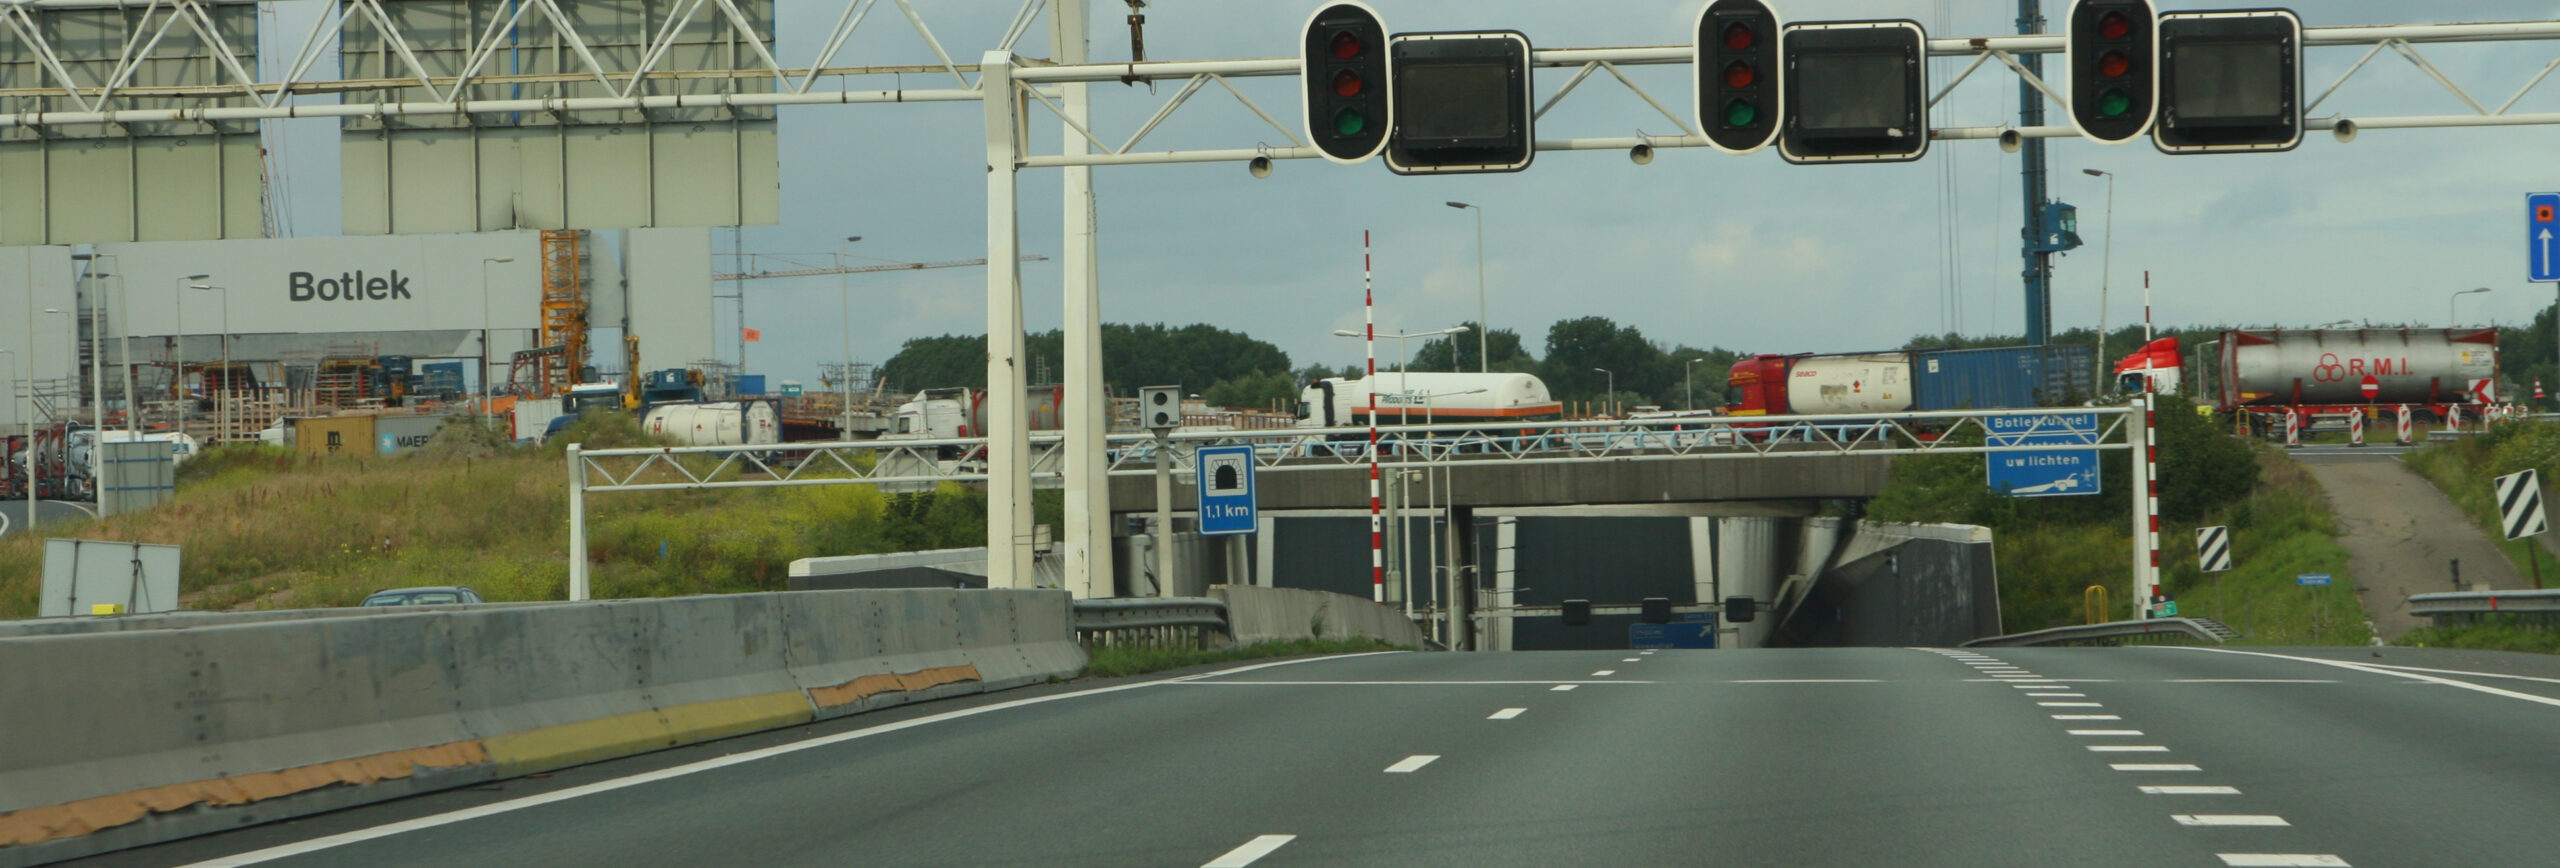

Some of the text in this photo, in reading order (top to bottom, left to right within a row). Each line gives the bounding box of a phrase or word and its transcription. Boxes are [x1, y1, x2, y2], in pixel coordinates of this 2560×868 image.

[290, 269, 412, 301] Botlek
[1995, 414, 2088, 428] Botlekunel
[2006, 455, 2080, 467] uw lichten
[1225, 504, 1249, 517] km
